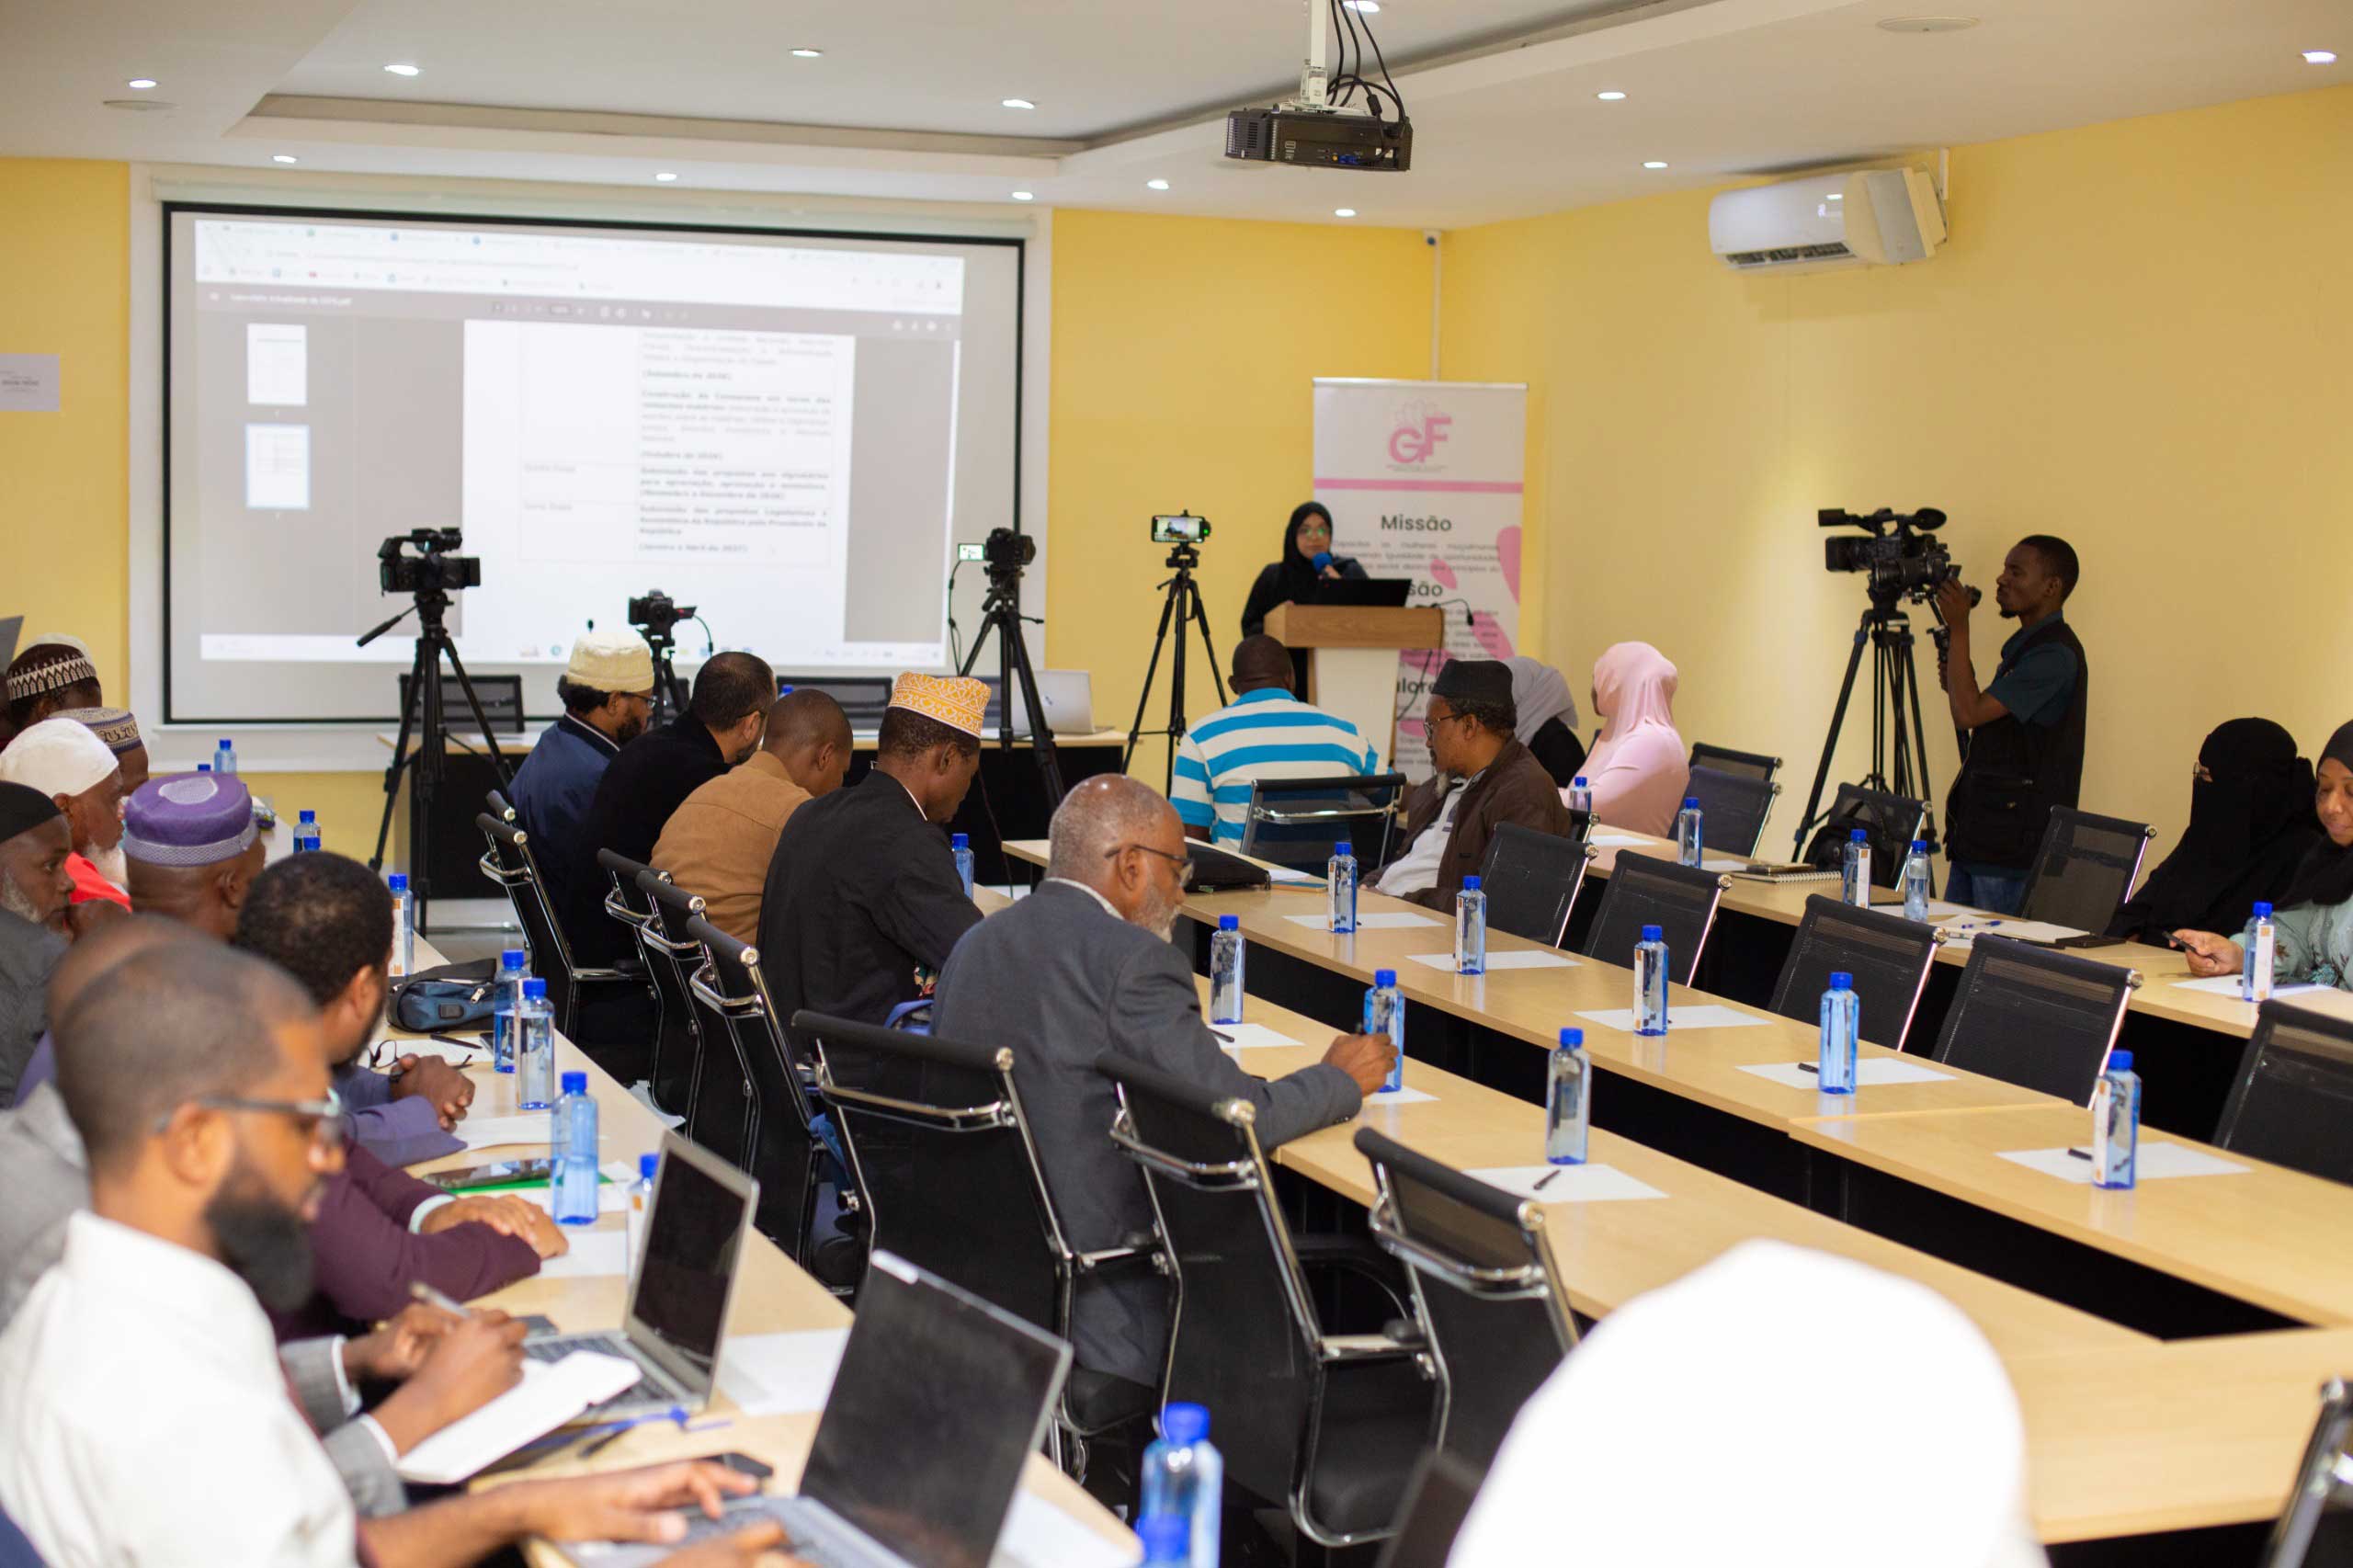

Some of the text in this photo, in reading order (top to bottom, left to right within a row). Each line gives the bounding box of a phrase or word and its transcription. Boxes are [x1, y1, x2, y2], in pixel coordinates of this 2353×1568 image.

[1389, 416, 1452, 463] GF
[1381, 514, 1452, 531] Missão
[1408, 581, 1443, 597] são
